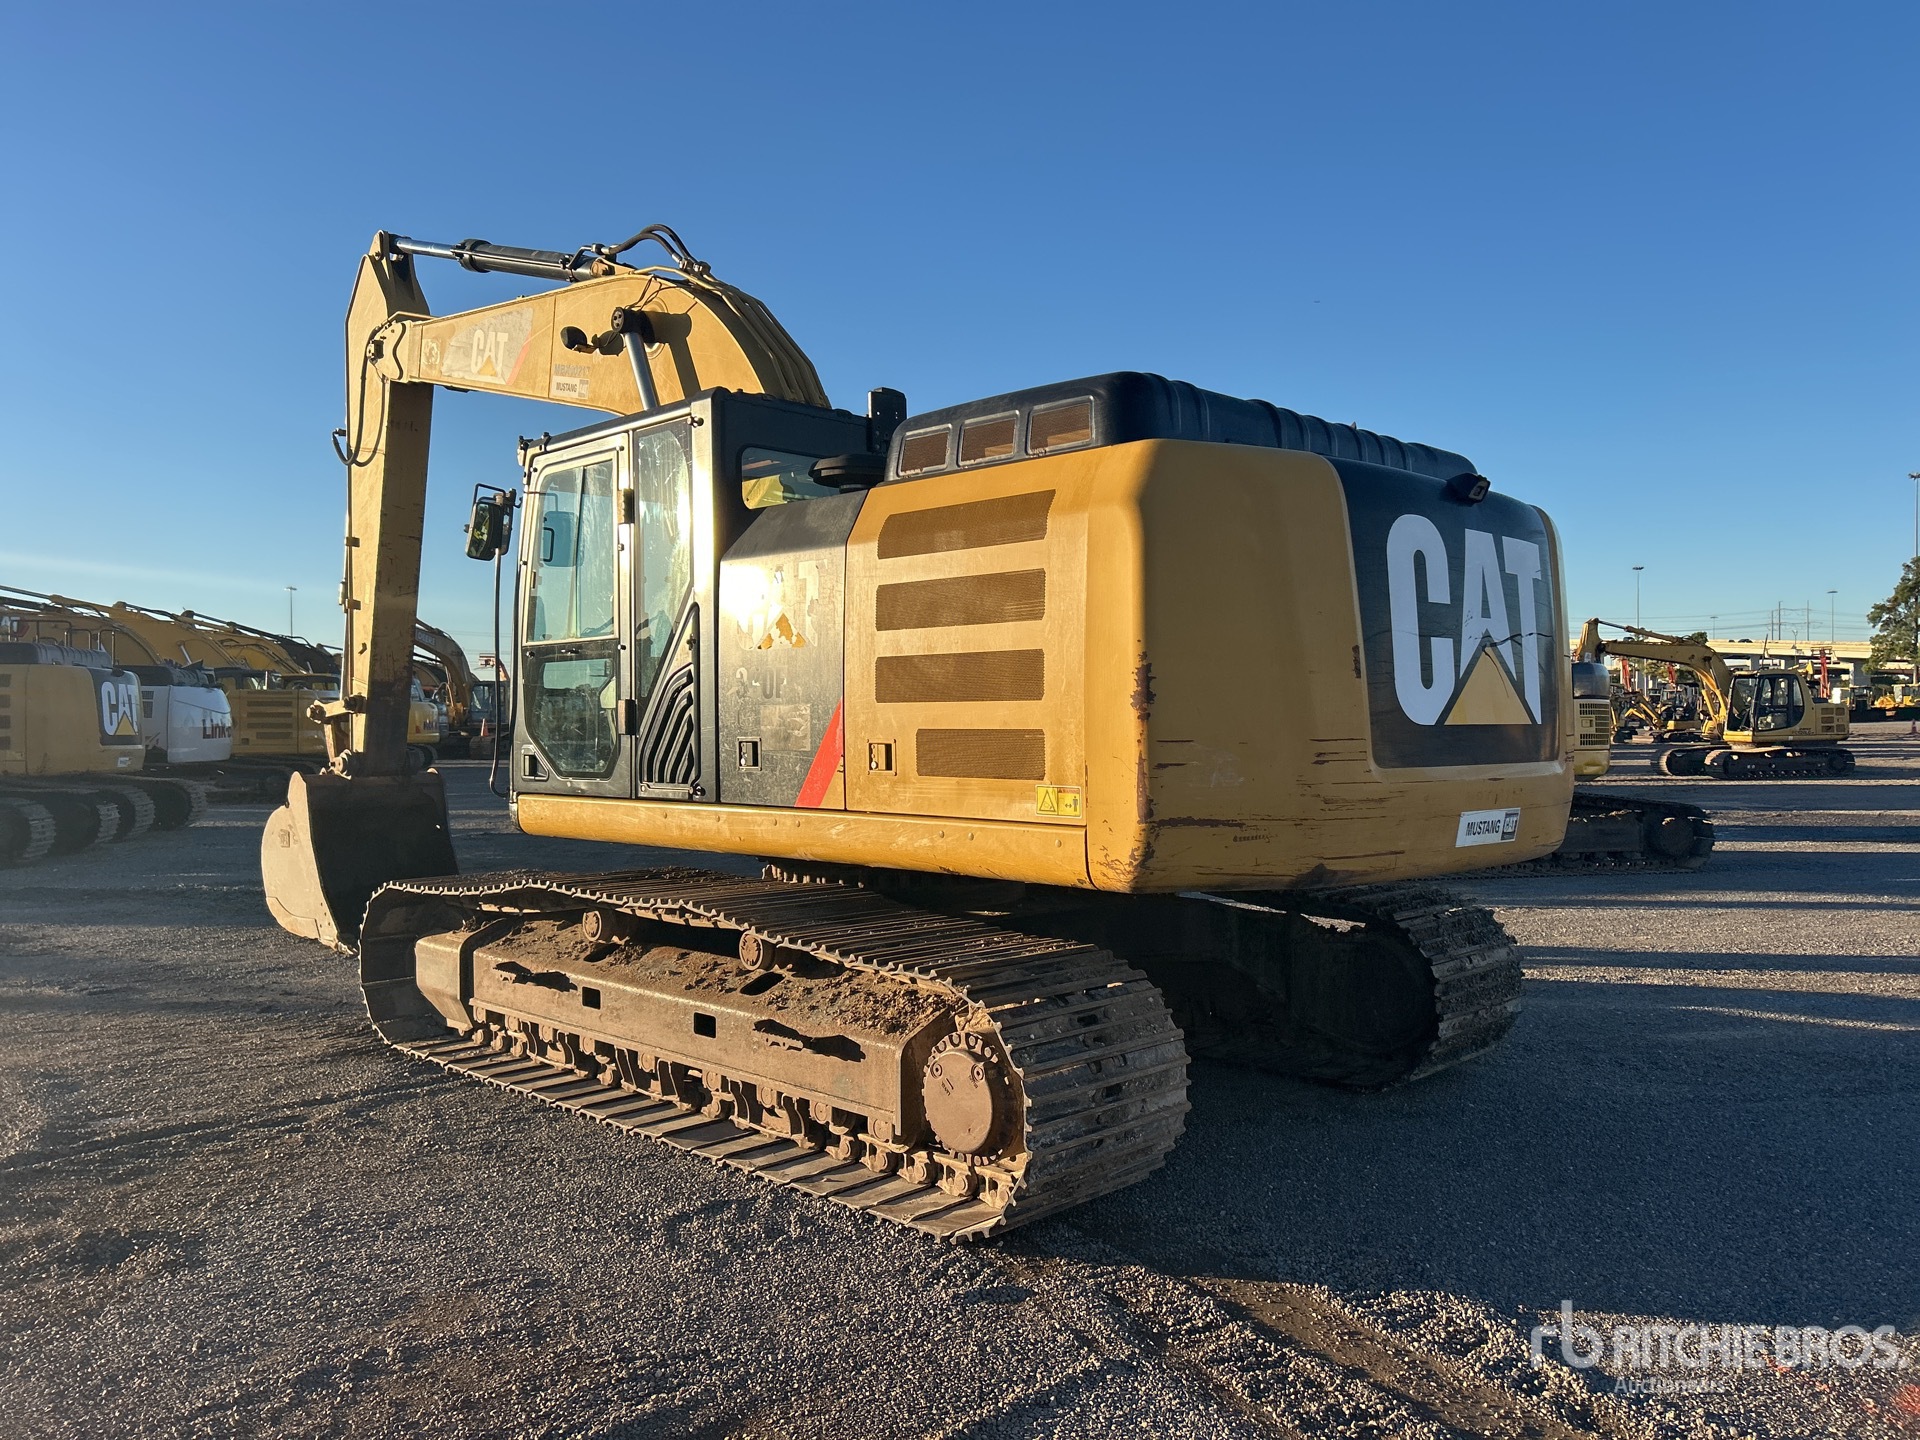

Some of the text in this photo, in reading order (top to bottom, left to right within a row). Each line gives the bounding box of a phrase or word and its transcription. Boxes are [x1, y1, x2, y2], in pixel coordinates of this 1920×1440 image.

[471, 329, 508, 377] CAT
[556, 382, 578, 393] MUSTANG
[1386, 513, 1542, 726] CAT
[101, 681, 139, 736] CAT
[1466, 819, 1501, 837] MUSTANG
